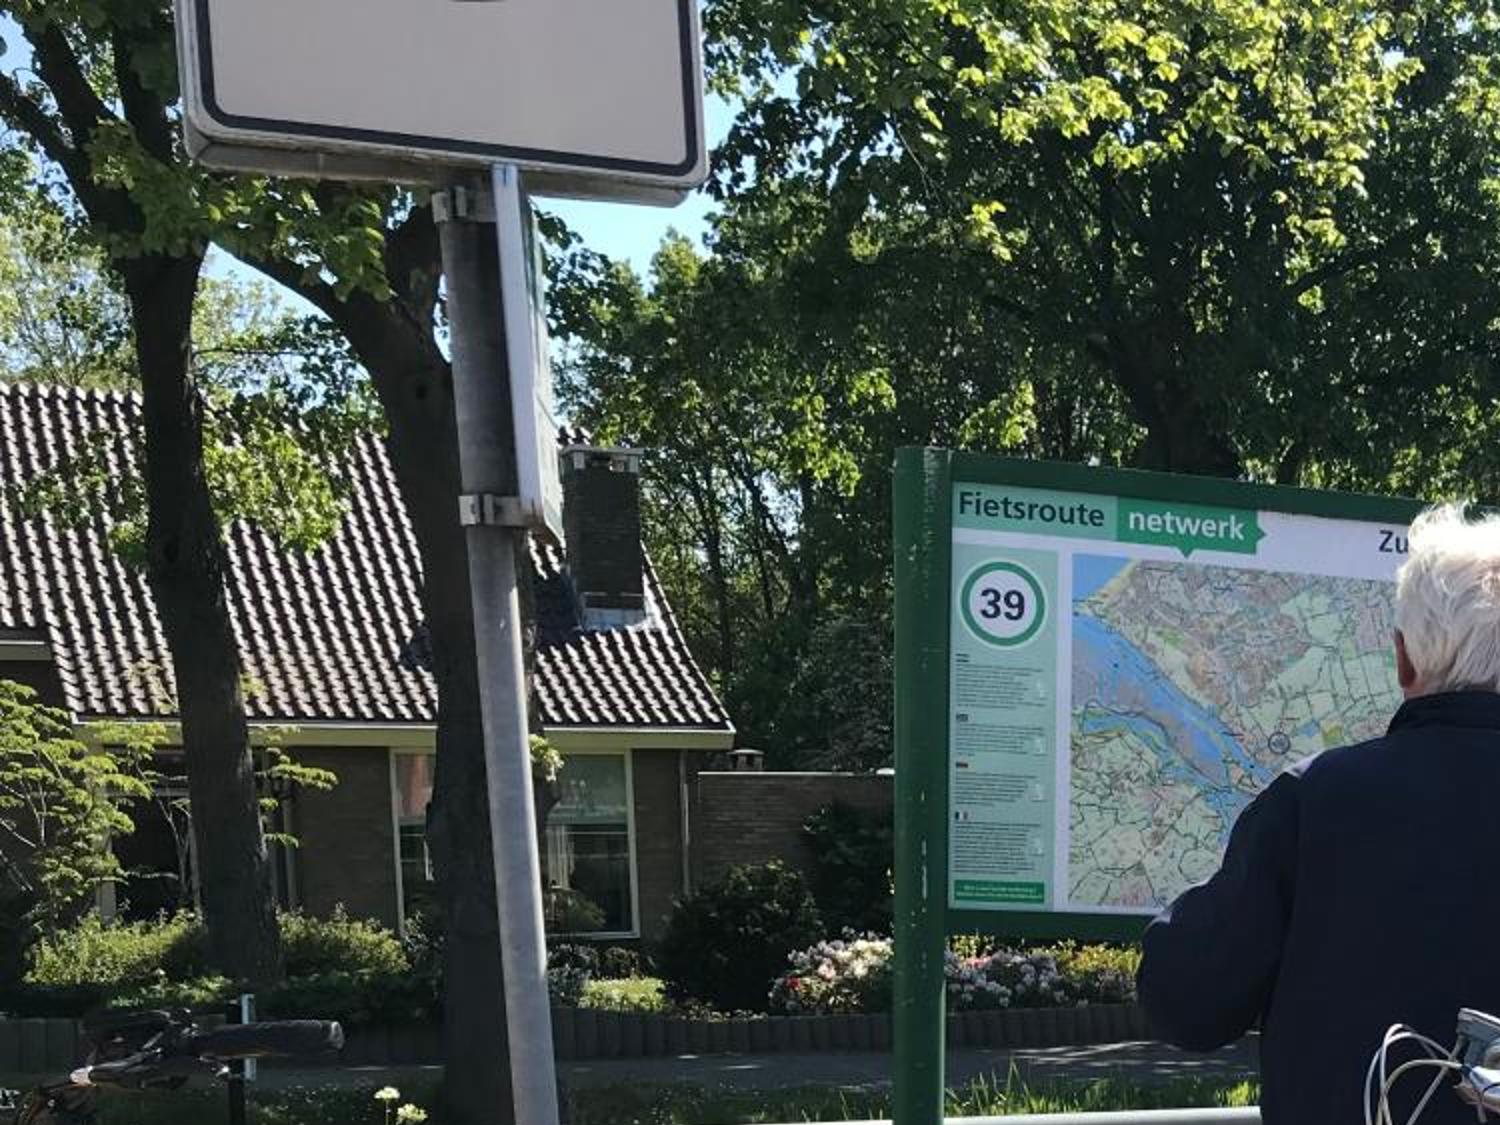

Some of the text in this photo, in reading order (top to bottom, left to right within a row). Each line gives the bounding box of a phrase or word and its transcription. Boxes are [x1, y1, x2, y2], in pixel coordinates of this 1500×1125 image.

[958, 490, 1245, 541] Fietsroute netwerk
[980, 588, 1025, 621] 39
